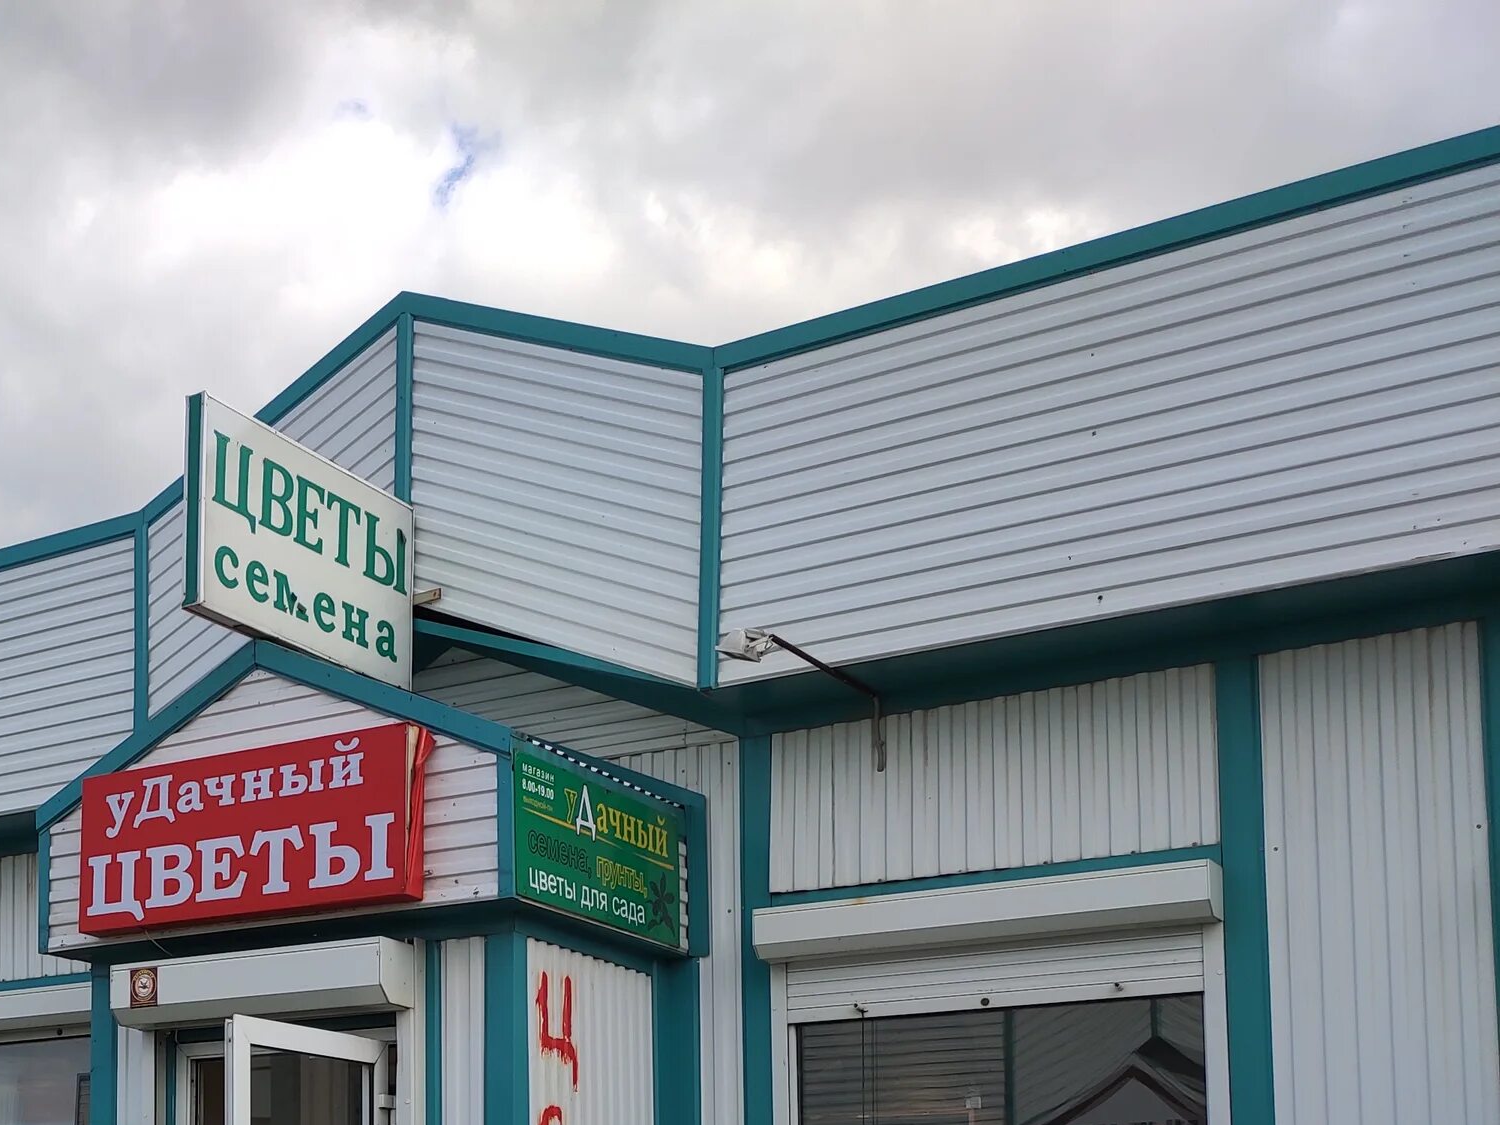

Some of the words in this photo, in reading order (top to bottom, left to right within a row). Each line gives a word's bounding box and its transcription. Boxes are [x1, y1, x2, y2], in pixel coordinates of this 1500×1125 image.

[212, 429, 408, 597] ЦВЕТЫ
[104, 736, 364, 839] уДачный
[522, 762, 555, 783] магазин
[522, 778, 555, 800] 8.00-19.00
[564, 784, 670, 859] уДачный
[86, 812, 396, 922] ЦВЕТЫ
[529, 866, 576, 902] цветы
[581, 884, 609, 912] для
[612, 897, 646, 927] сада
